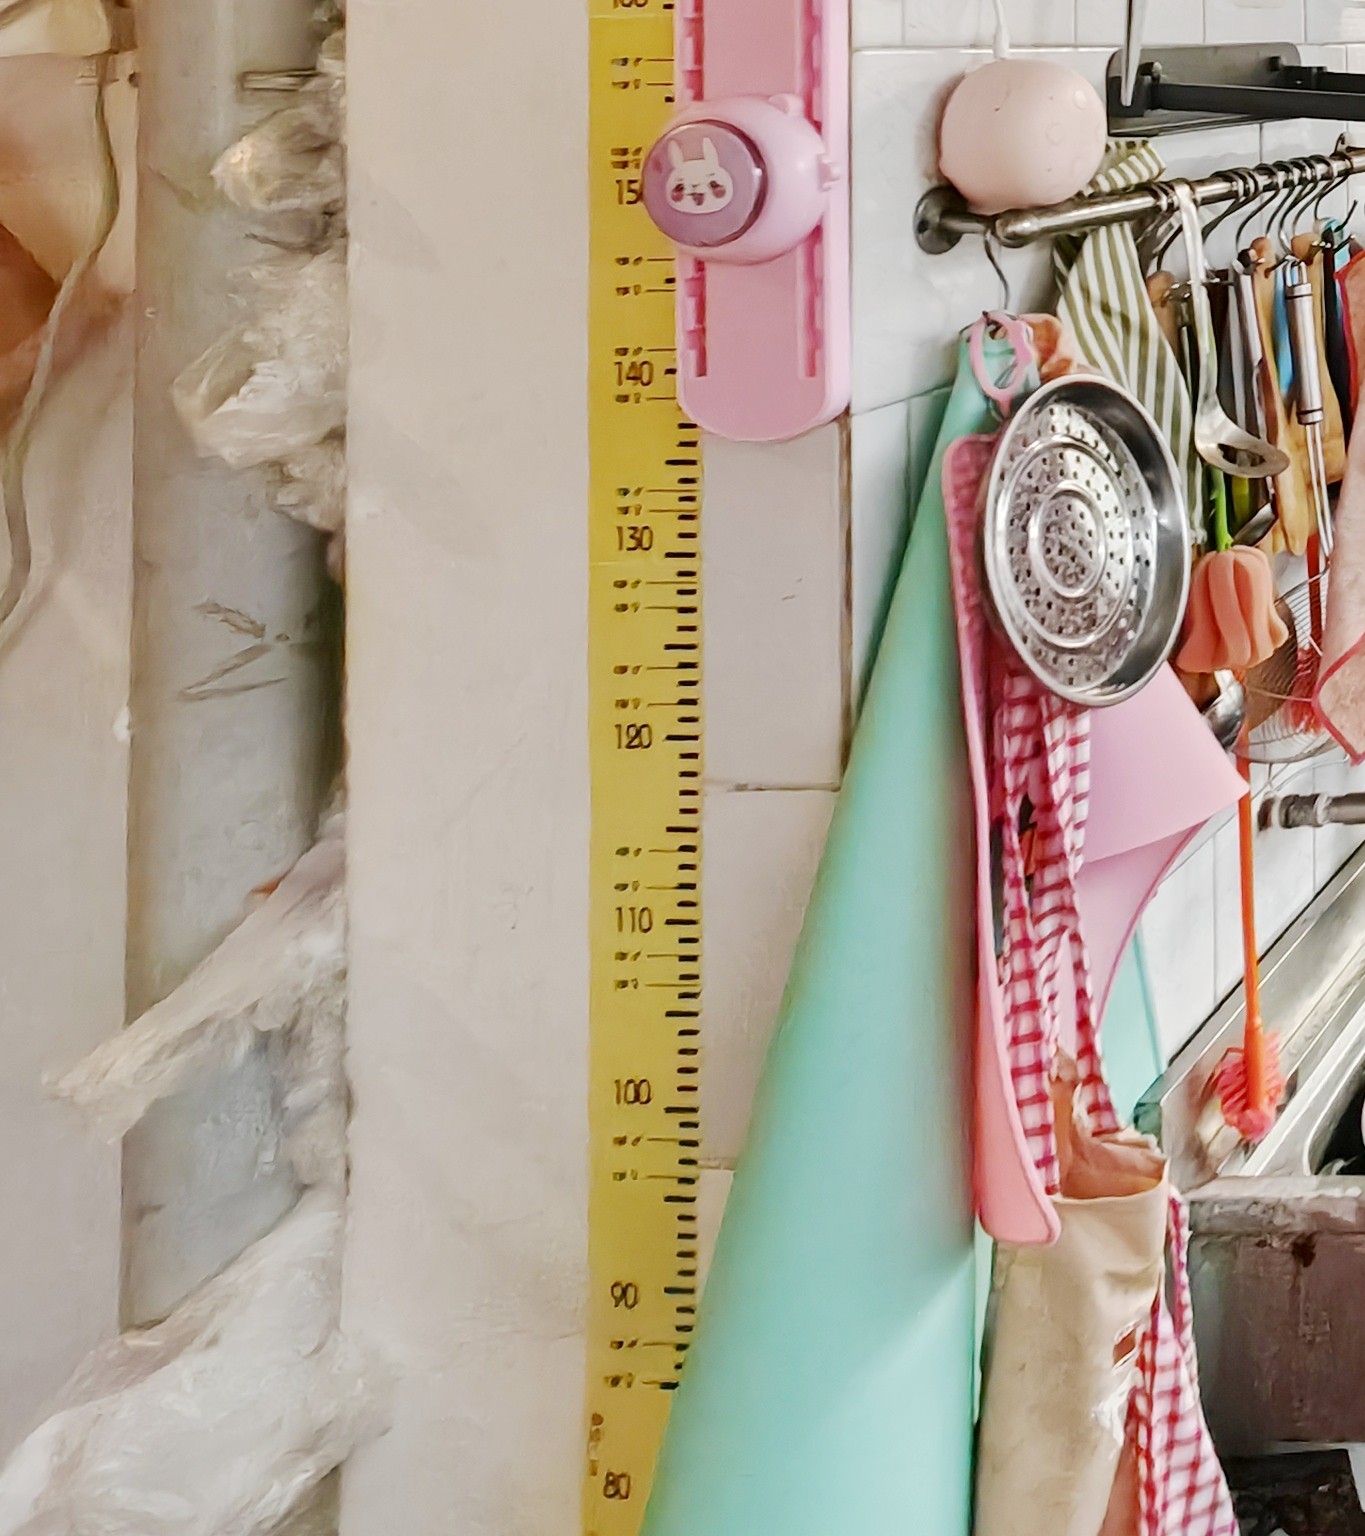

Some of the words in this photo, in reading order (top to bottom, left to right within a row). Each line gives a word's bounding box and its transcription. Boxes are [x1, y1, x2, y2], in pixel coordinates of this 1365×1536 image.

[615, 179, 643, 206] 15
[613, 361, 654, 387] 140
[616, 526, 654, 551] 130
[613, 724, 653, 750] 120
[614, 907, 653, 934] 110
[613, 1079, 653, 1106] 100
[610, 1281, 639, 1310] 90
[602, 1470, 631, 1500] 80
